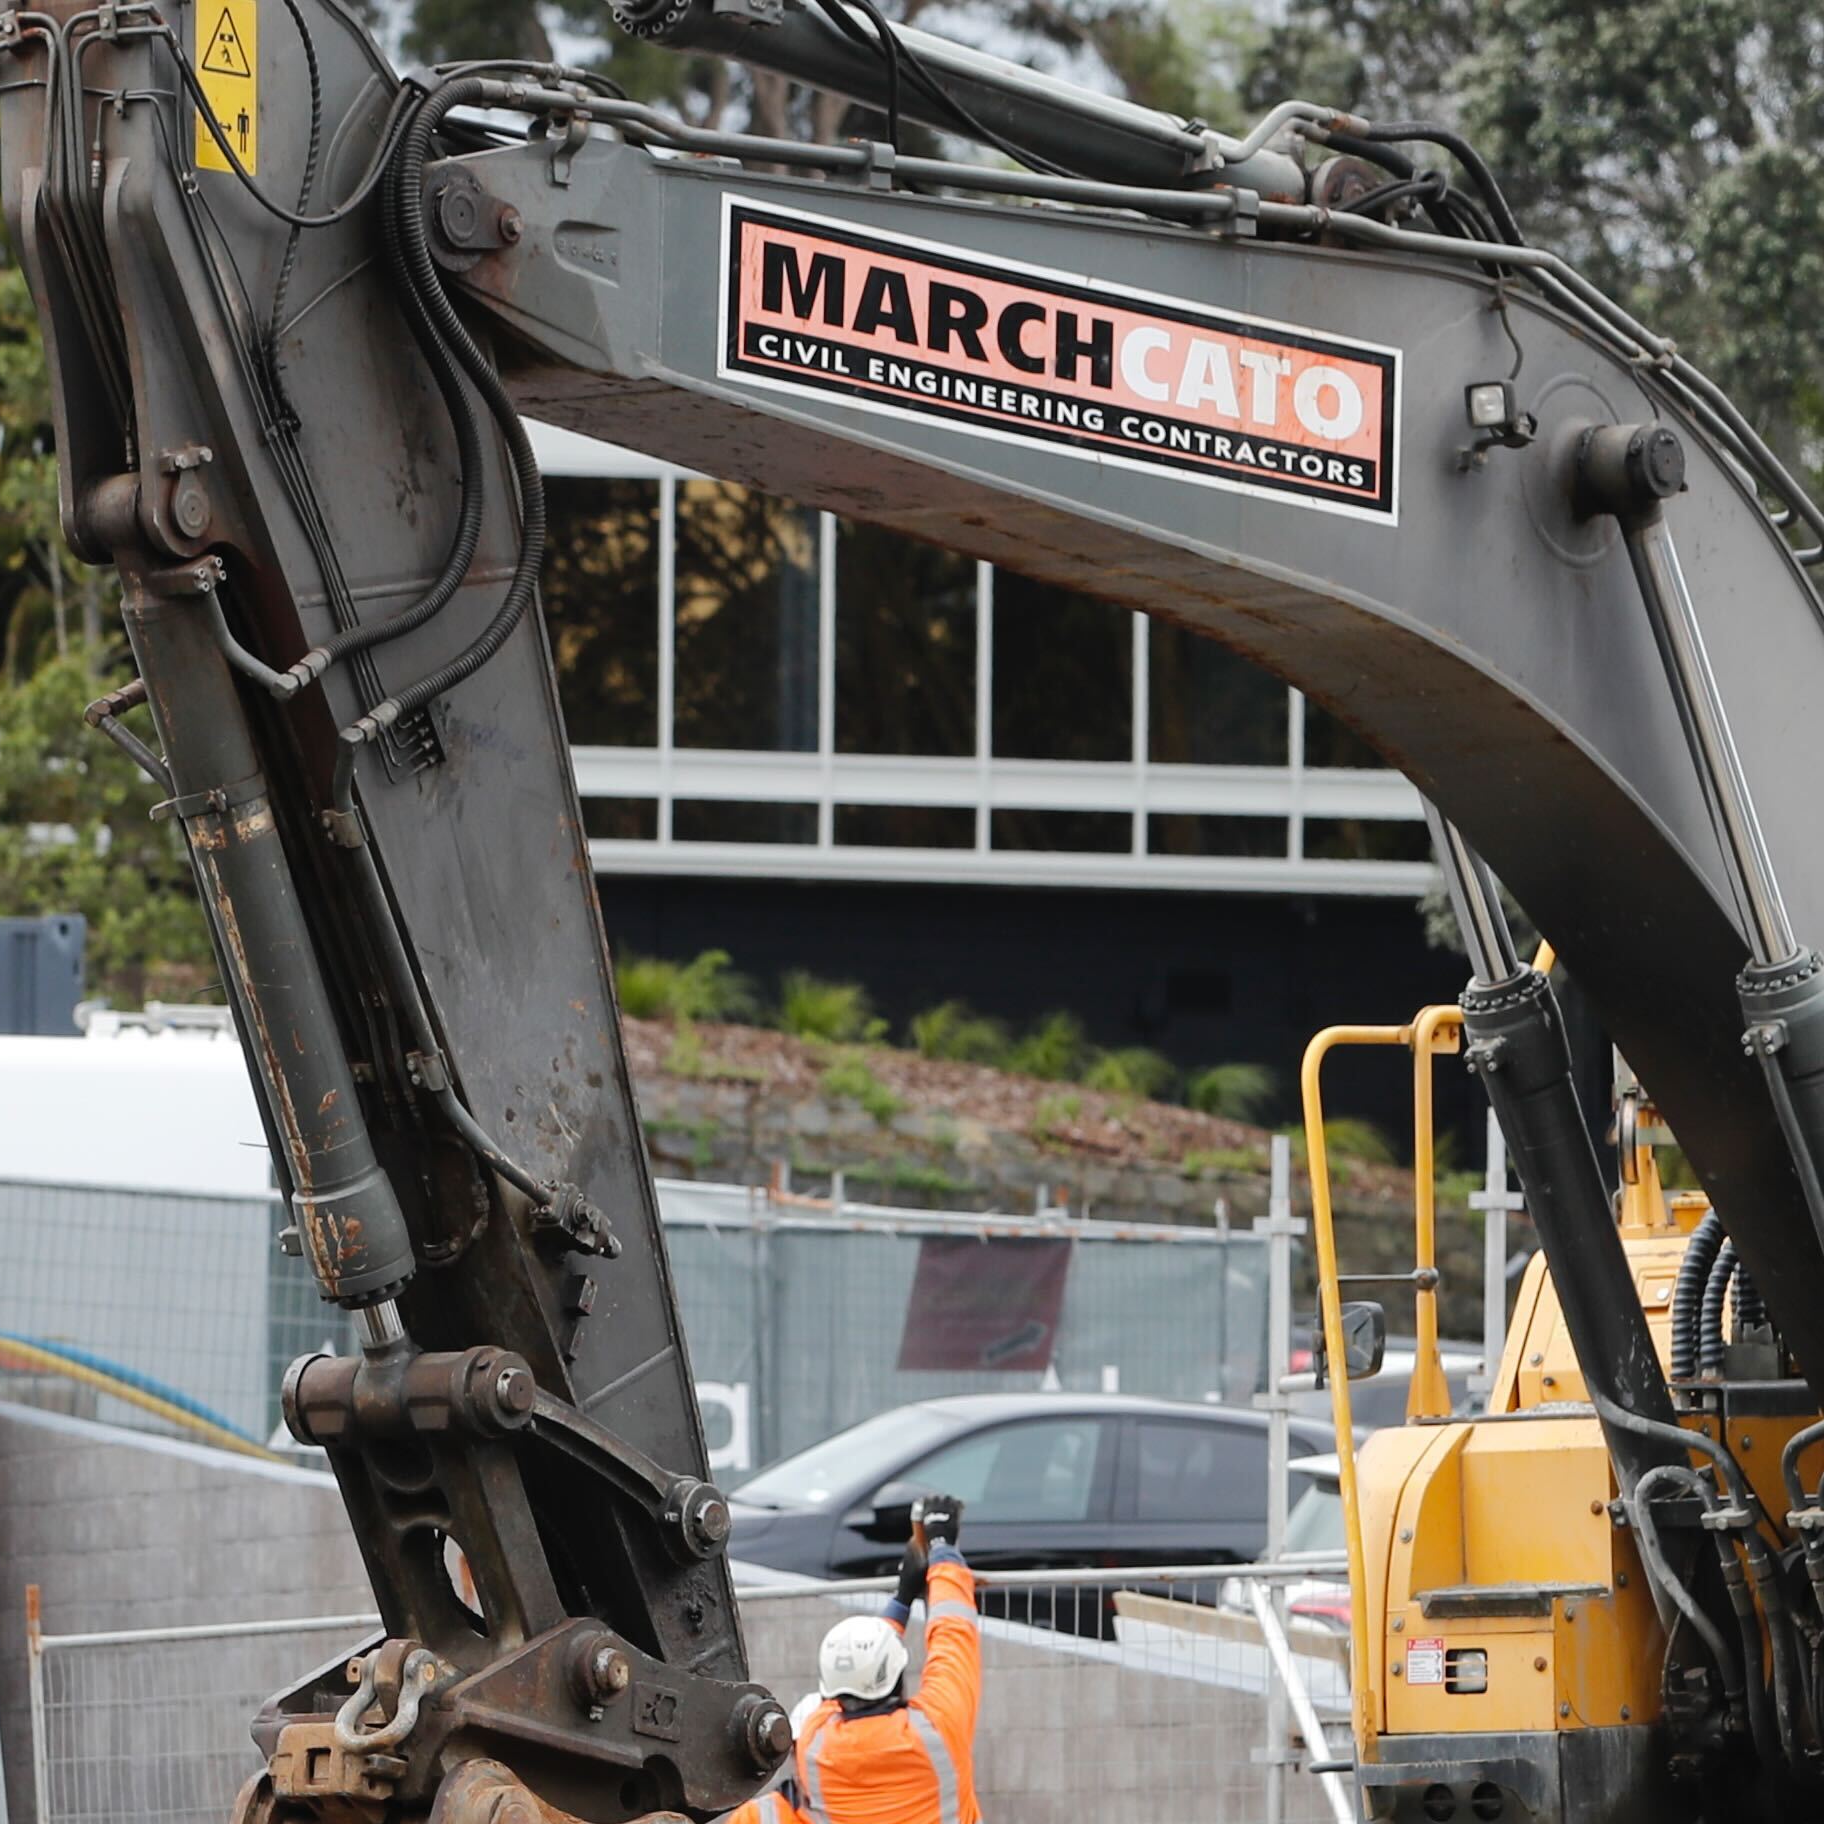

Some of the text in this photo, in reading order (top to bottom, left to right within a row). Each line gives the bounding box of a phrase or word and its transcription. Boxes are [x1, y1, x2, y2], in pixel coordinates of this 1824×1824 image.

[758, 333, 1365, 487] CIVIL ENGINEERING CONTRACTORS
[761, 240, 1363, 440] MARCHCATO
